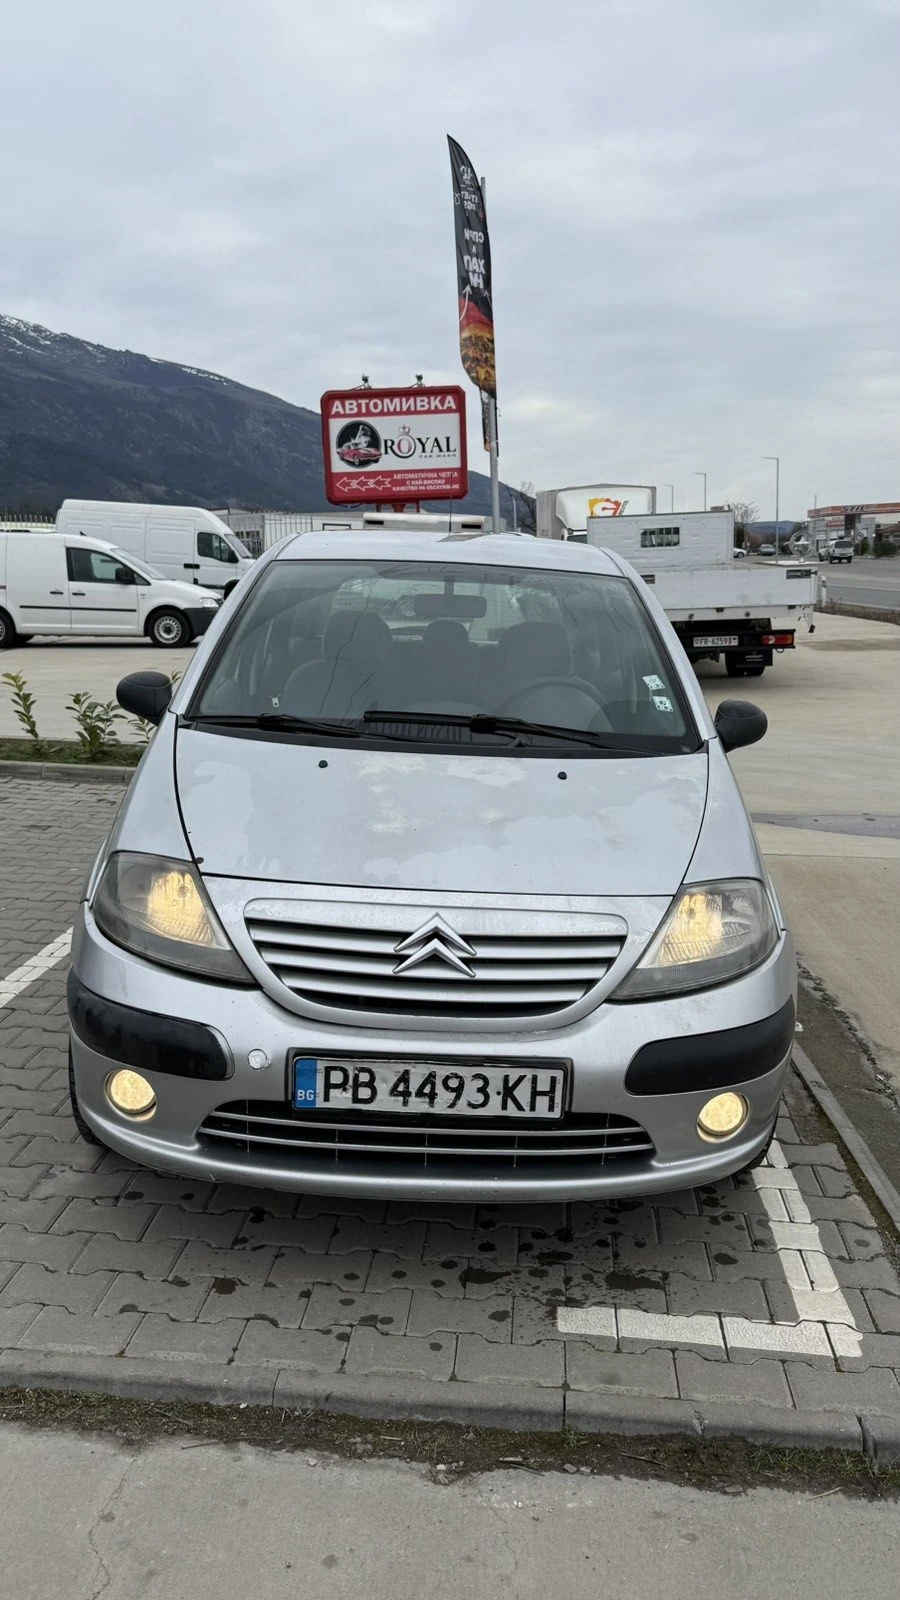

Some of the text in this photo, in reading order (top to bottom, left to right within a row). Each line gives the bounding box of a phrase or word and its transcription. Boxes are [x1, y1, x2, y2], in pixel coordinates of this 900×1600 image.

[331, 395, 457, 415] АВТОМИВКА
[383, 434, 457, 459] ROYAL
[297, 1089, 315, 1101] BG
[323, 1065, 557, 1113] PB 4493 KH
